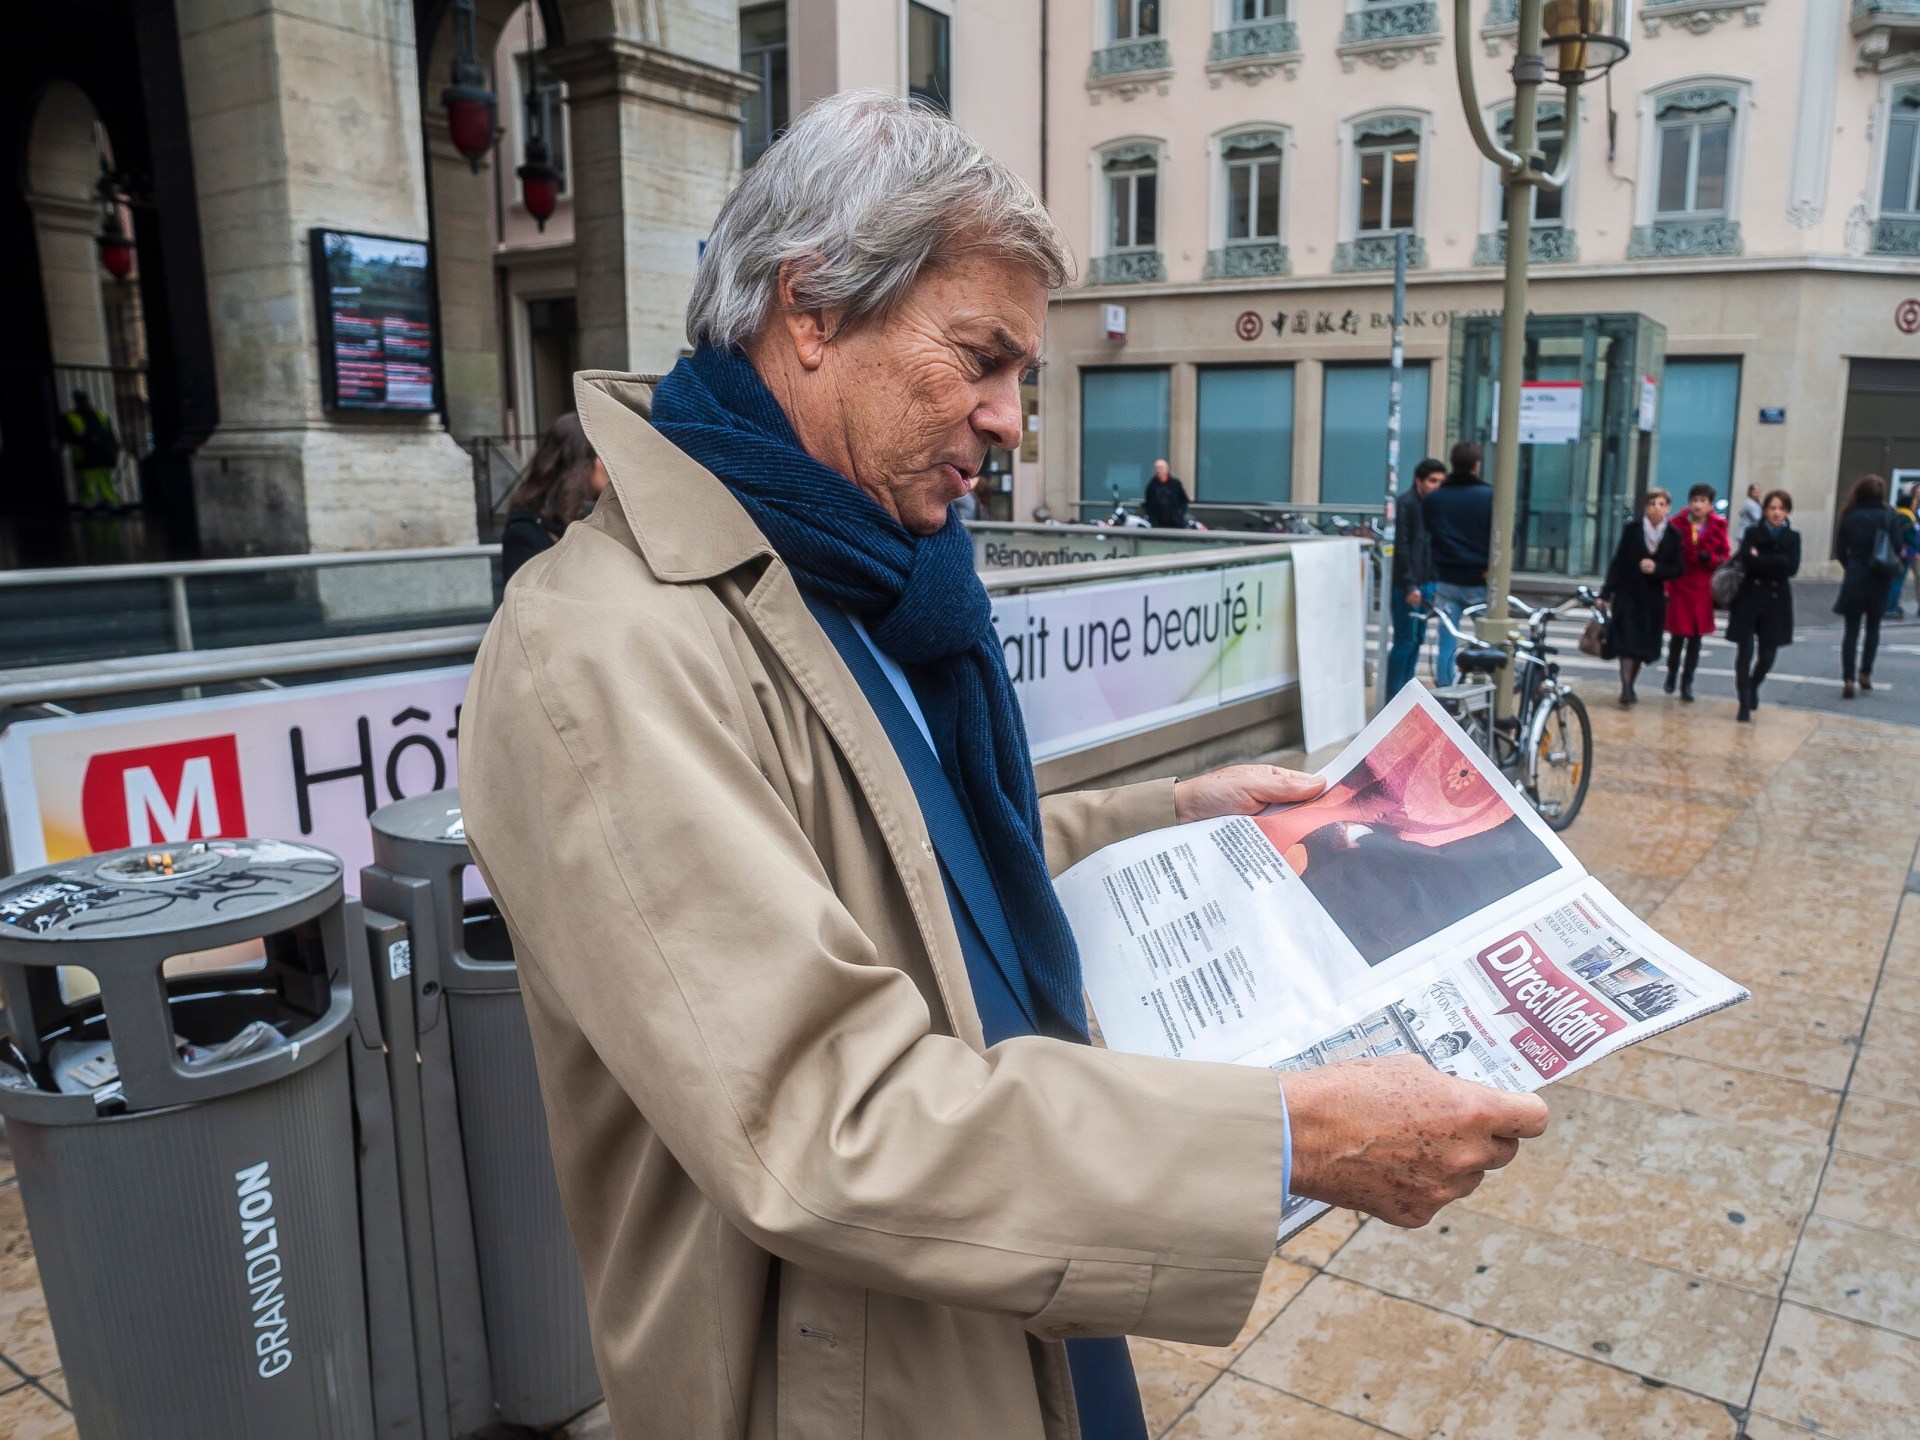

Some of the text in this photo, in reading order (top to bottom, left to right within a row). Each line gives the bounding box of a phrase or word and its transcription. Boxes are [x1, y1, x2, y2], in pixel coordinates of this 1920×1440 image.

[985, 542, 1096, 567] Rénovation
[993, 581, 1263, 683] ait une beauté !
[122, 756, 222, 847] M
[1542, 913, 1561, 933] JOUER
[1552, 909, 1577, 936] VEULENT
[1560, 904, 1574, 917] LES
[1429, 986, 1466, 1033] LYON PEUT
[1518, 1033, 1559, 1072] LyonPLUS
